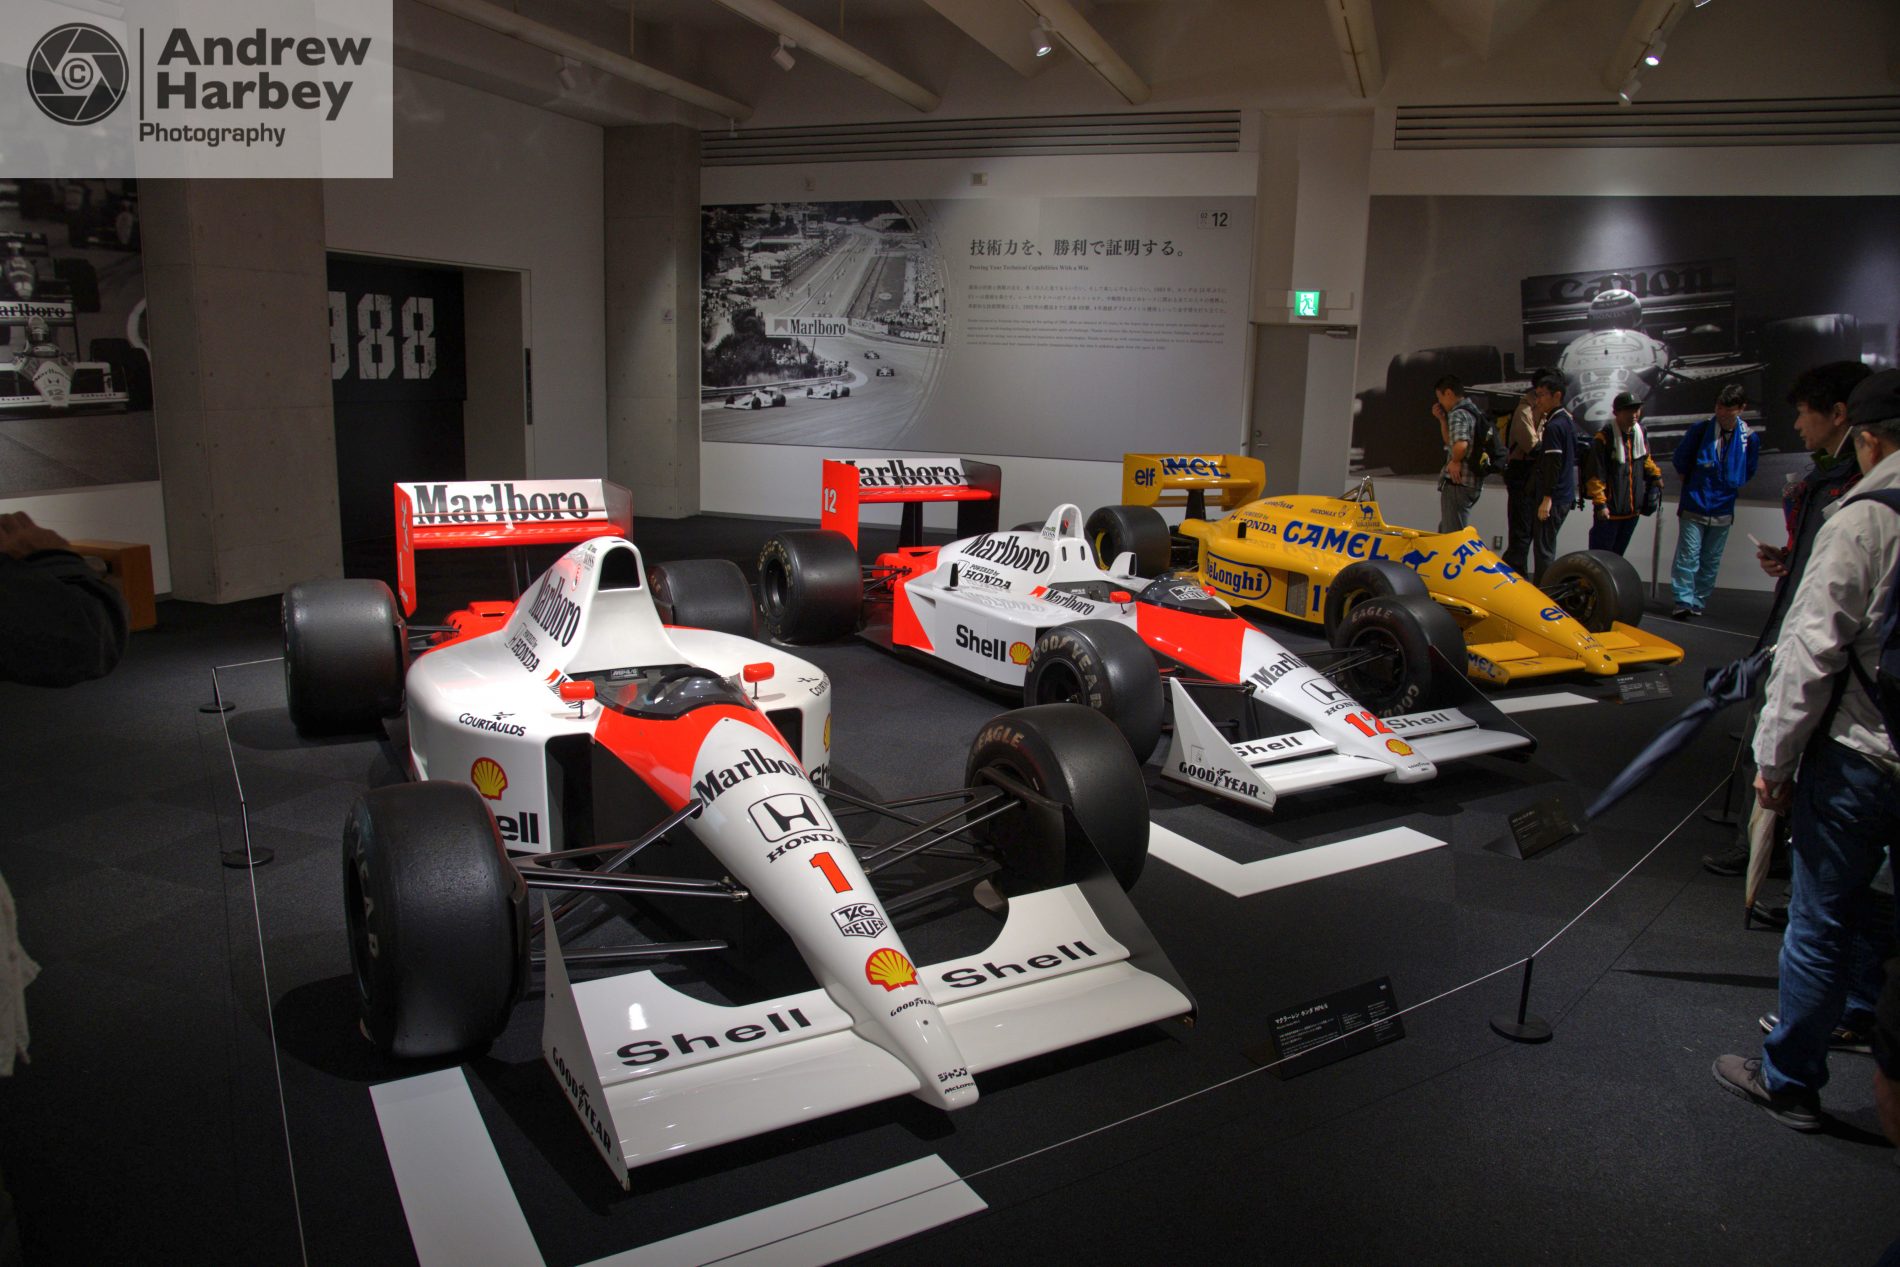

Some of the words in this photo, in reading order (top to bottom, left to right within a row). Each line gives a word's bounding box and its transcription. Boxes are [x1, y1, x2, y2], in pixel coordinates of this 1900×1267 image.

[1211, 211, 1229, 227] 12
[969, 238, 1185, 258] 技術力を、勝利で証明する。
[0, 303, 66, 318] arlboro
[790, 318, 846, 336] Marlboro
[1135, 468, 1156, 487] elf
[1160, 458, 1231, 479] MEL
[414, 483, 589, 525] Marlboro
[823, 487, 837, 514] 12
[1240, 518, 1277, 535] ONDA
[1283, 519, 1389, 561] CAMEL
[960, 532, 1050, 575] Marlboro
[1443, 539, 1490, 580] CAM
[963, 569, 1012, 590] HONDA
[969, 563, 991, 575] POWERED
[528, 568, 581, 648] Marlboro
[1043, 587, 1096, 616] Marlboro
[1351, 606, 1393, 623] EAGLE
[1540, 605, 1571, 622] el
[511, 637, 540, 673] HONDA
[956, 624, 1006, 662] Shell
[1468, 652, 1496, 679] MEL
[459, 712, 527, 737] COURTAULDS
[1344, 711, 1393, 738] 12
[1386, 712, 1451, 732] Shell
[977, 725, 1025, 750] EAGLE
[1234, 736, 1304, 758] Shell
[693, 748, 808, 809] Marlbor
[1179, 761, 1259, 799] GOODYEAR
[496, 811, 540, 845] ell
[766, 833, 850, 864] HONDA
[809, 851, 854, 894] 1
[838, 904, 875, 921] TAG
[843, 918, 886, 937] HEUER
[941, 940, 1098, 989] Shell
[616, 1008, 812, 1067] Shell
[552, 1046, 612, 1154] GOODYEAR
